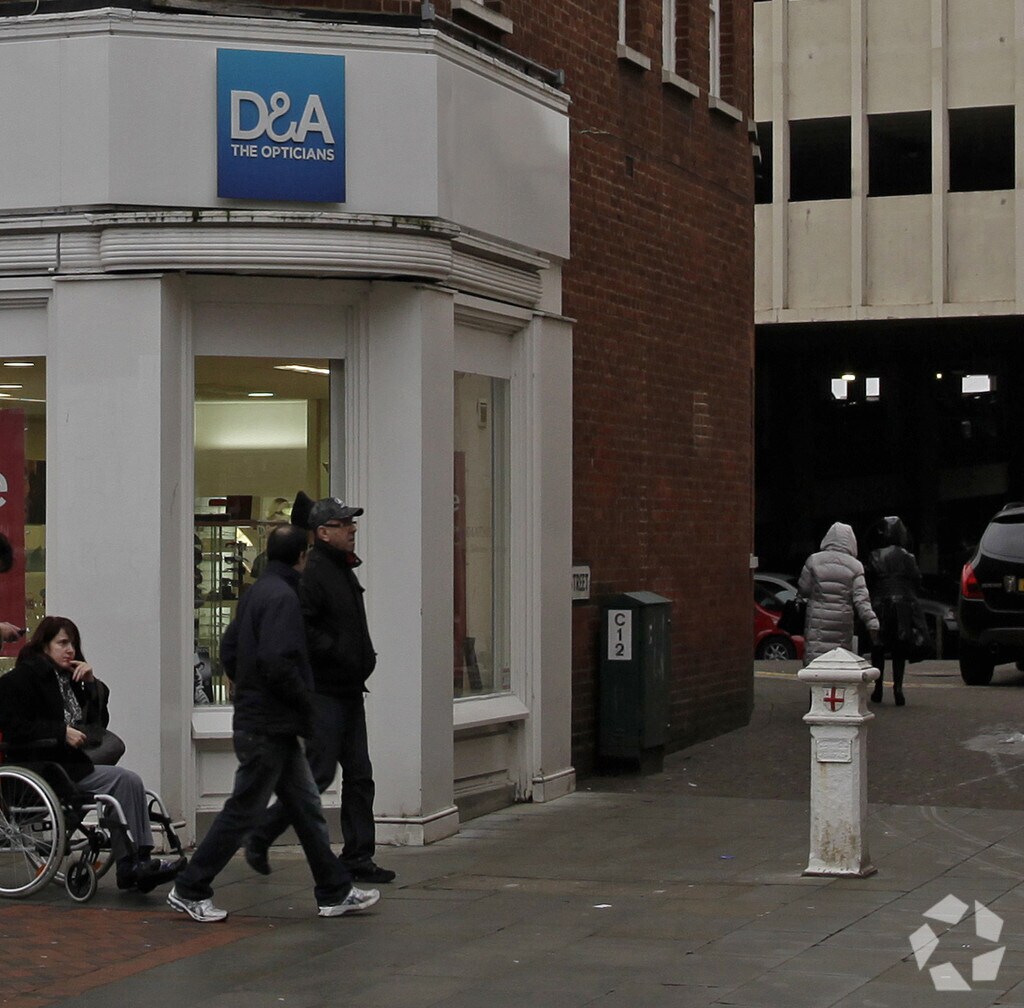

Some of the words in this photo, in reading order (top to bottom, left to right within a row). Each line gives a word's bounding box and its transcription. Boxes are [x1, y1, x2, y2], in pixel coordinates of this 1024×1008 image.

[230, 89, 335, 145] D&A
[231, 144, 258, 157] THE
[261, 145, 335, 161] OPTICIANS
[572, 573, 589, 592] TREET
